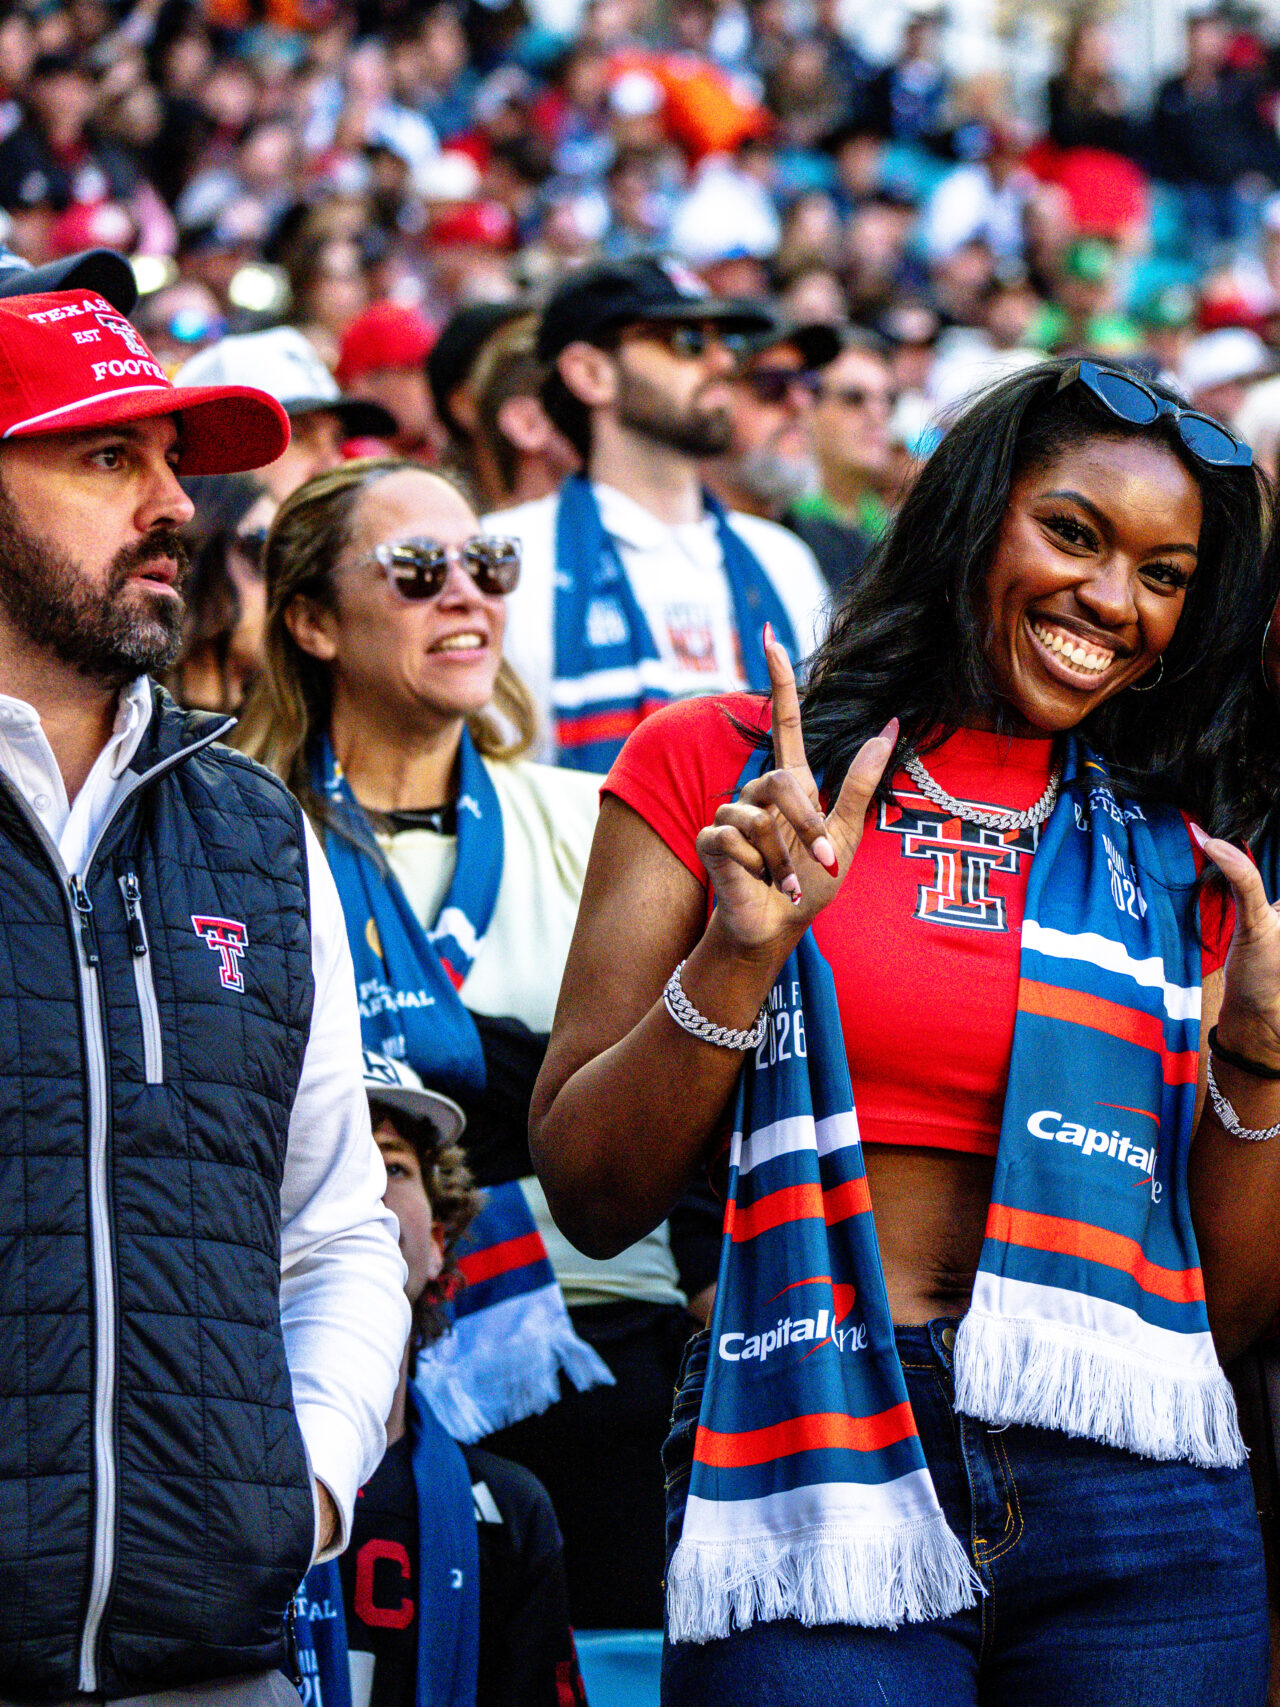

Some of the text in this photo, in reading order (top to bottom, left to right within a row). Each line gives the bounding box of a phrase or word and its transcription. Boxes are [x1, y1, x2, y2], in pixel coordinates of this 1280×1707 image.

[28, 299, 111, 324] TEXAS
[72, 329, 101, 344] EST
[1027, 1110, 1156, 1176] Capital
[718, 1309, 830, 1362] Capital
